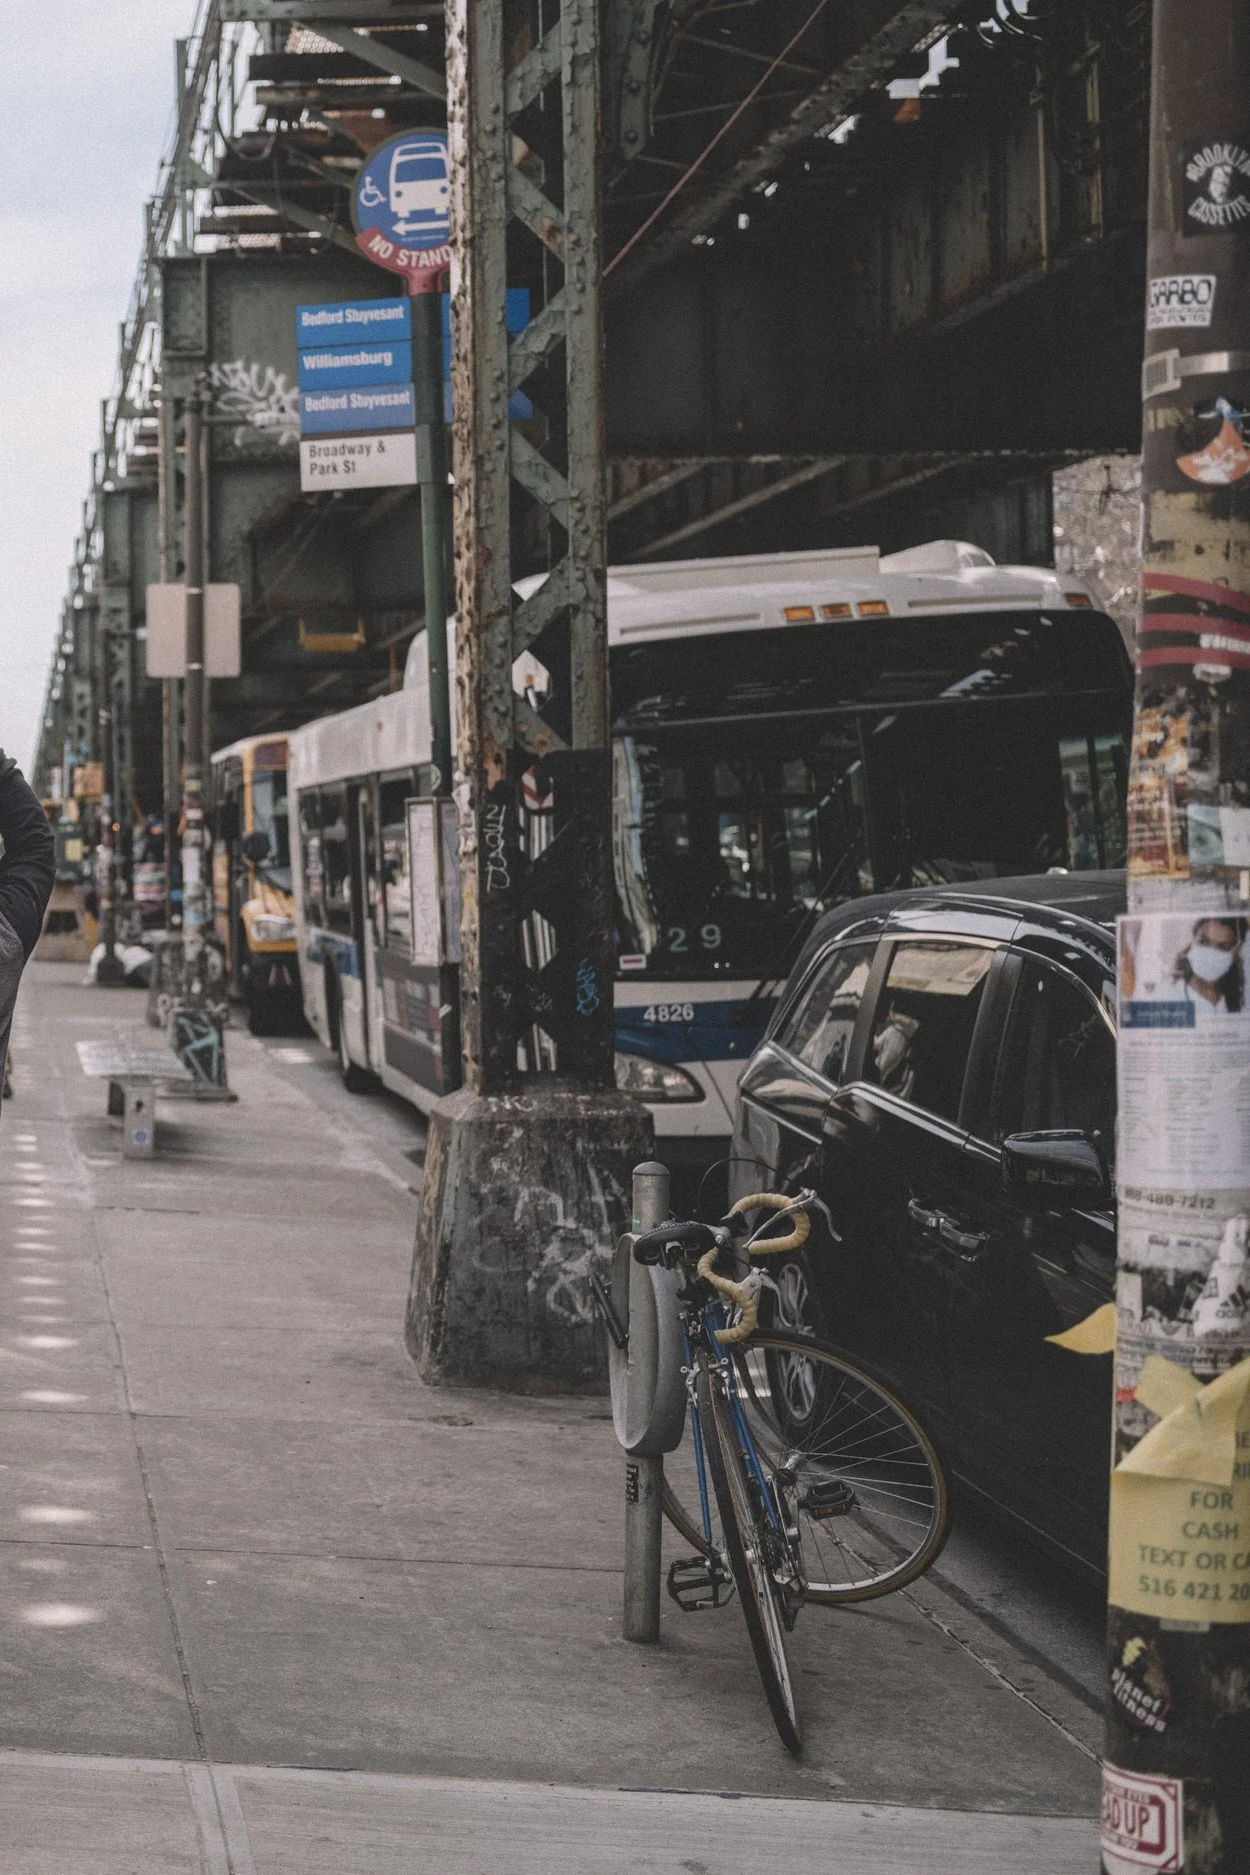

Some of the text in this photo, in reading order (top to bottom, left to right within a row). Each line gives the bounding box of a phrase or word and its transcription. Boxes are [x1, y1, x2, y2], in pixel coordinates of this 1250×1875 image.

[367, 235, 394, 259] NO
[301, 305, 404, 327] Bedford Stuyvesant
[302, 351, 393, 370] Williamsburg
[304, 390, 411, 412] Bedford Stuyvesant
[308, 439, 386, 458] Broadway &
[309, 460, 356, 475] Park St
[643, 1004, 694, 1022] 4826
[1190, 1491, 1233, 1510] FOR
[1182, 1521, 1239, 1540] CASH
[1139, 1544, 1187, 1568] TEXT
[1196, 1552, 1227, 1570] OR
[1139, 1574, 1177, 1596] 516
[1183, 1582, 1221, 1600] 421
